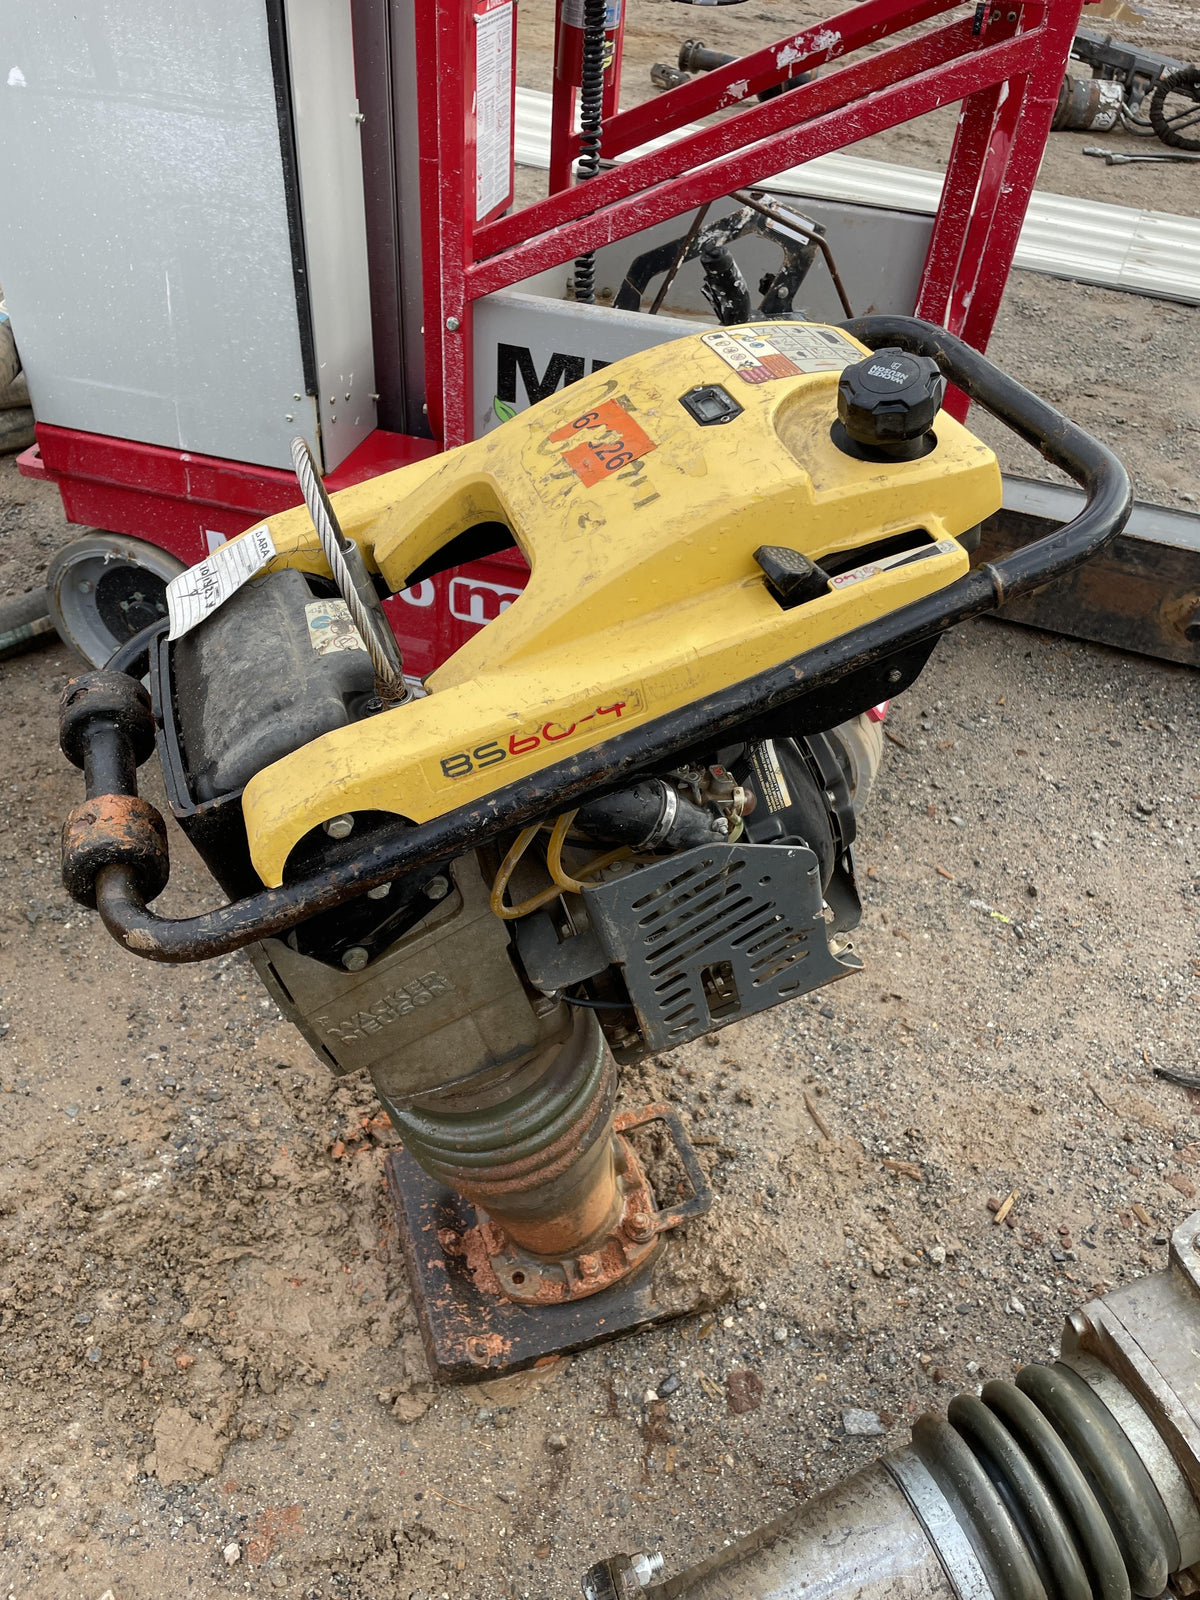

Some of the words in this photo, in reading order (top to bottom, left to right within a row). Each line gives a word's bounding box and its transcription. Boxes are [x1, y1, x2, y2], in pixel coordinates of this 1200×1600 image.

[867, 370, 904, 385] WACKER
[870, 364, 909, 381] NEUSON
[440, 702, 626, 778] BS60-4
